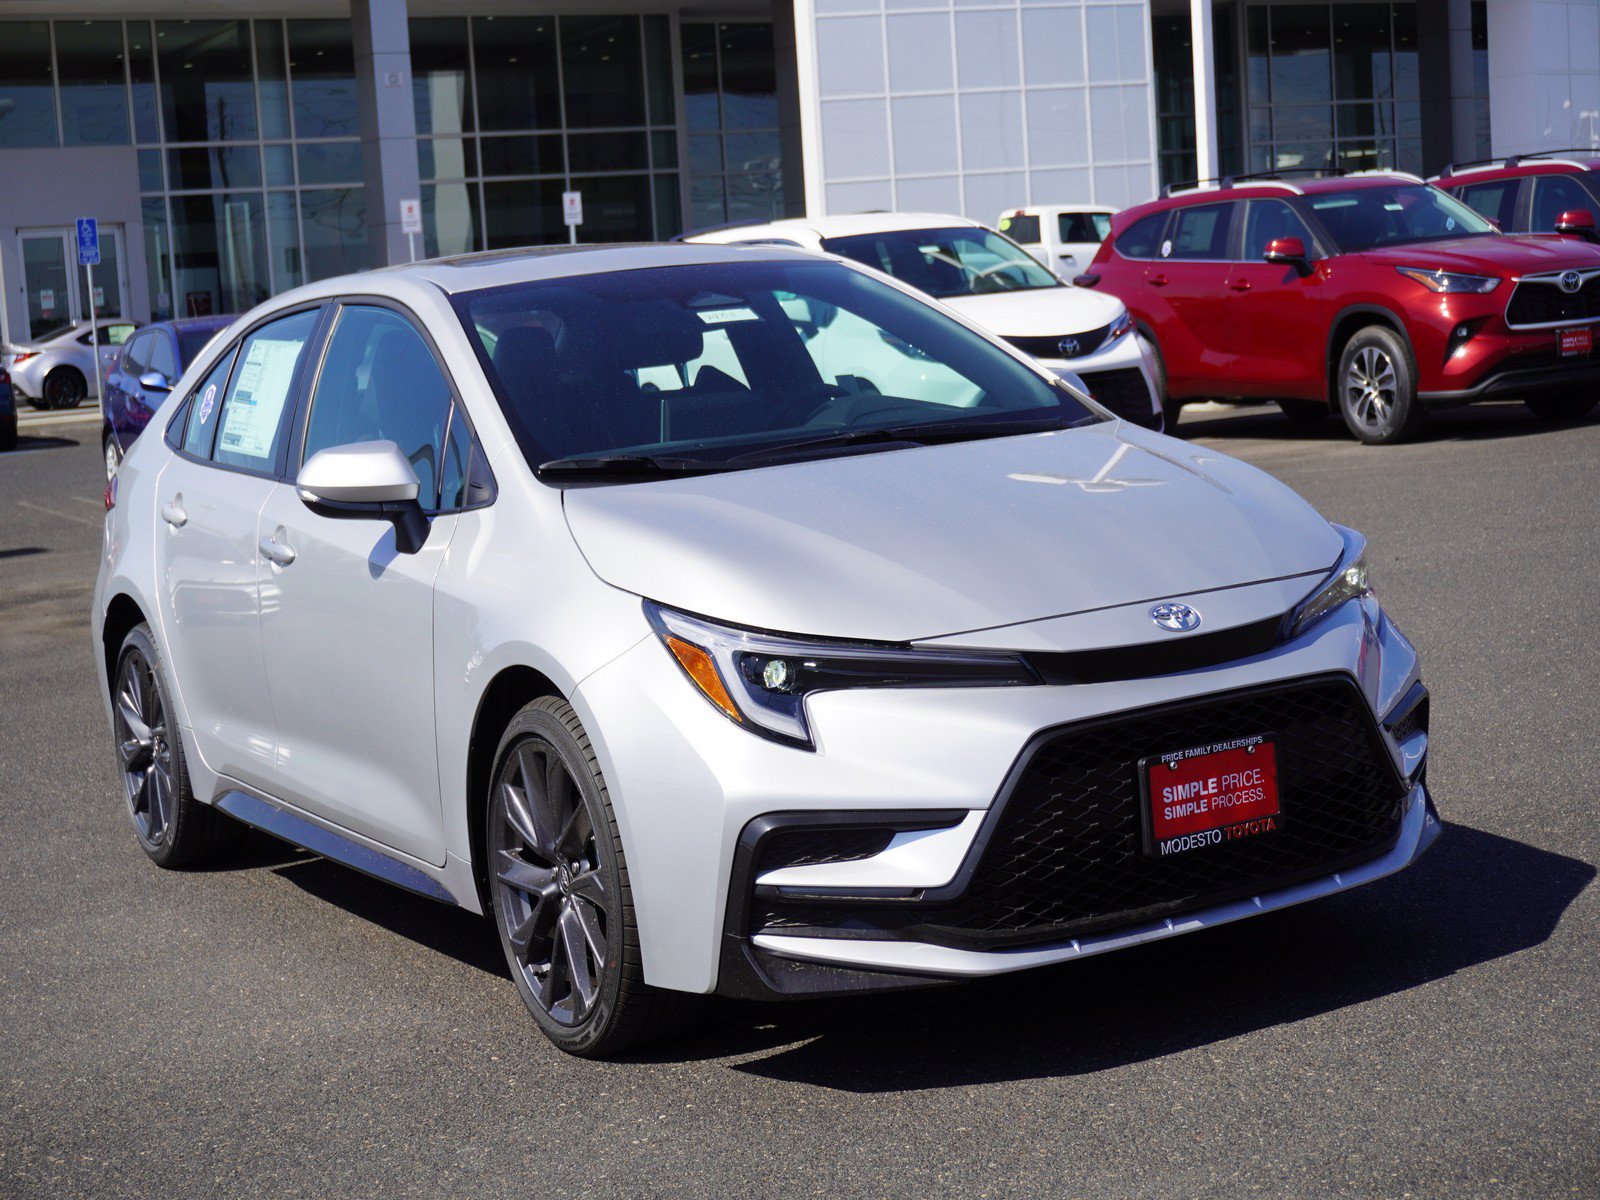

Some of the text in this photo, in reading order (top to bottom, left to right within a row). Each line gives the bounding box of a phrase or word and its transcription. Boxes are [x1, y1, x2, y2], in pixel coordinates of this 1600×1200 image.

[1161, 735, 1263, 763] PRICE FAMILY DEALERSHIPS
[1163, 768, 1265, 803] SIMPLE PRICE.
[1164, 787, 1266, 820] SIMPLE PROCESS.
[1160, 817, 1277, 856] MODESTO TOYOTA
